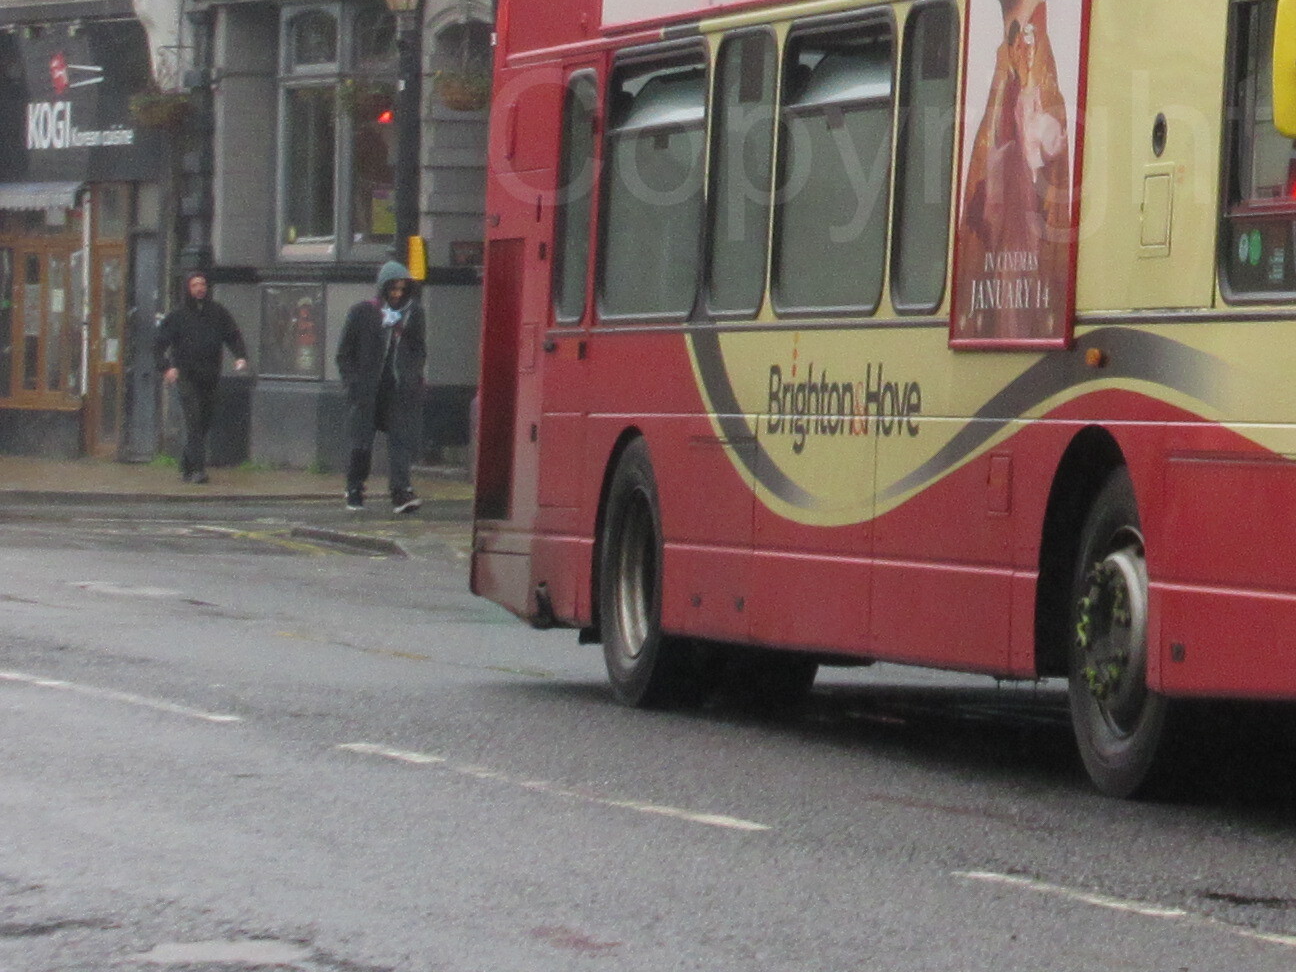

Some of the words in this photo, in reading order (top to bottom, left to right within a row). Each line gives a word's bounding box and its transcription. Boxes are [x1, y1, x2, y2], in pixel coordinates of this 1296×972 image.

[26, 101, 71, 150] KOGI
[984, 252, 996, 272] IN
[998, 251, 1039, 271] CINEMAS
[967, 278, 1031, 319] JANUARY
[1036, 278, 1050, 309] 14
